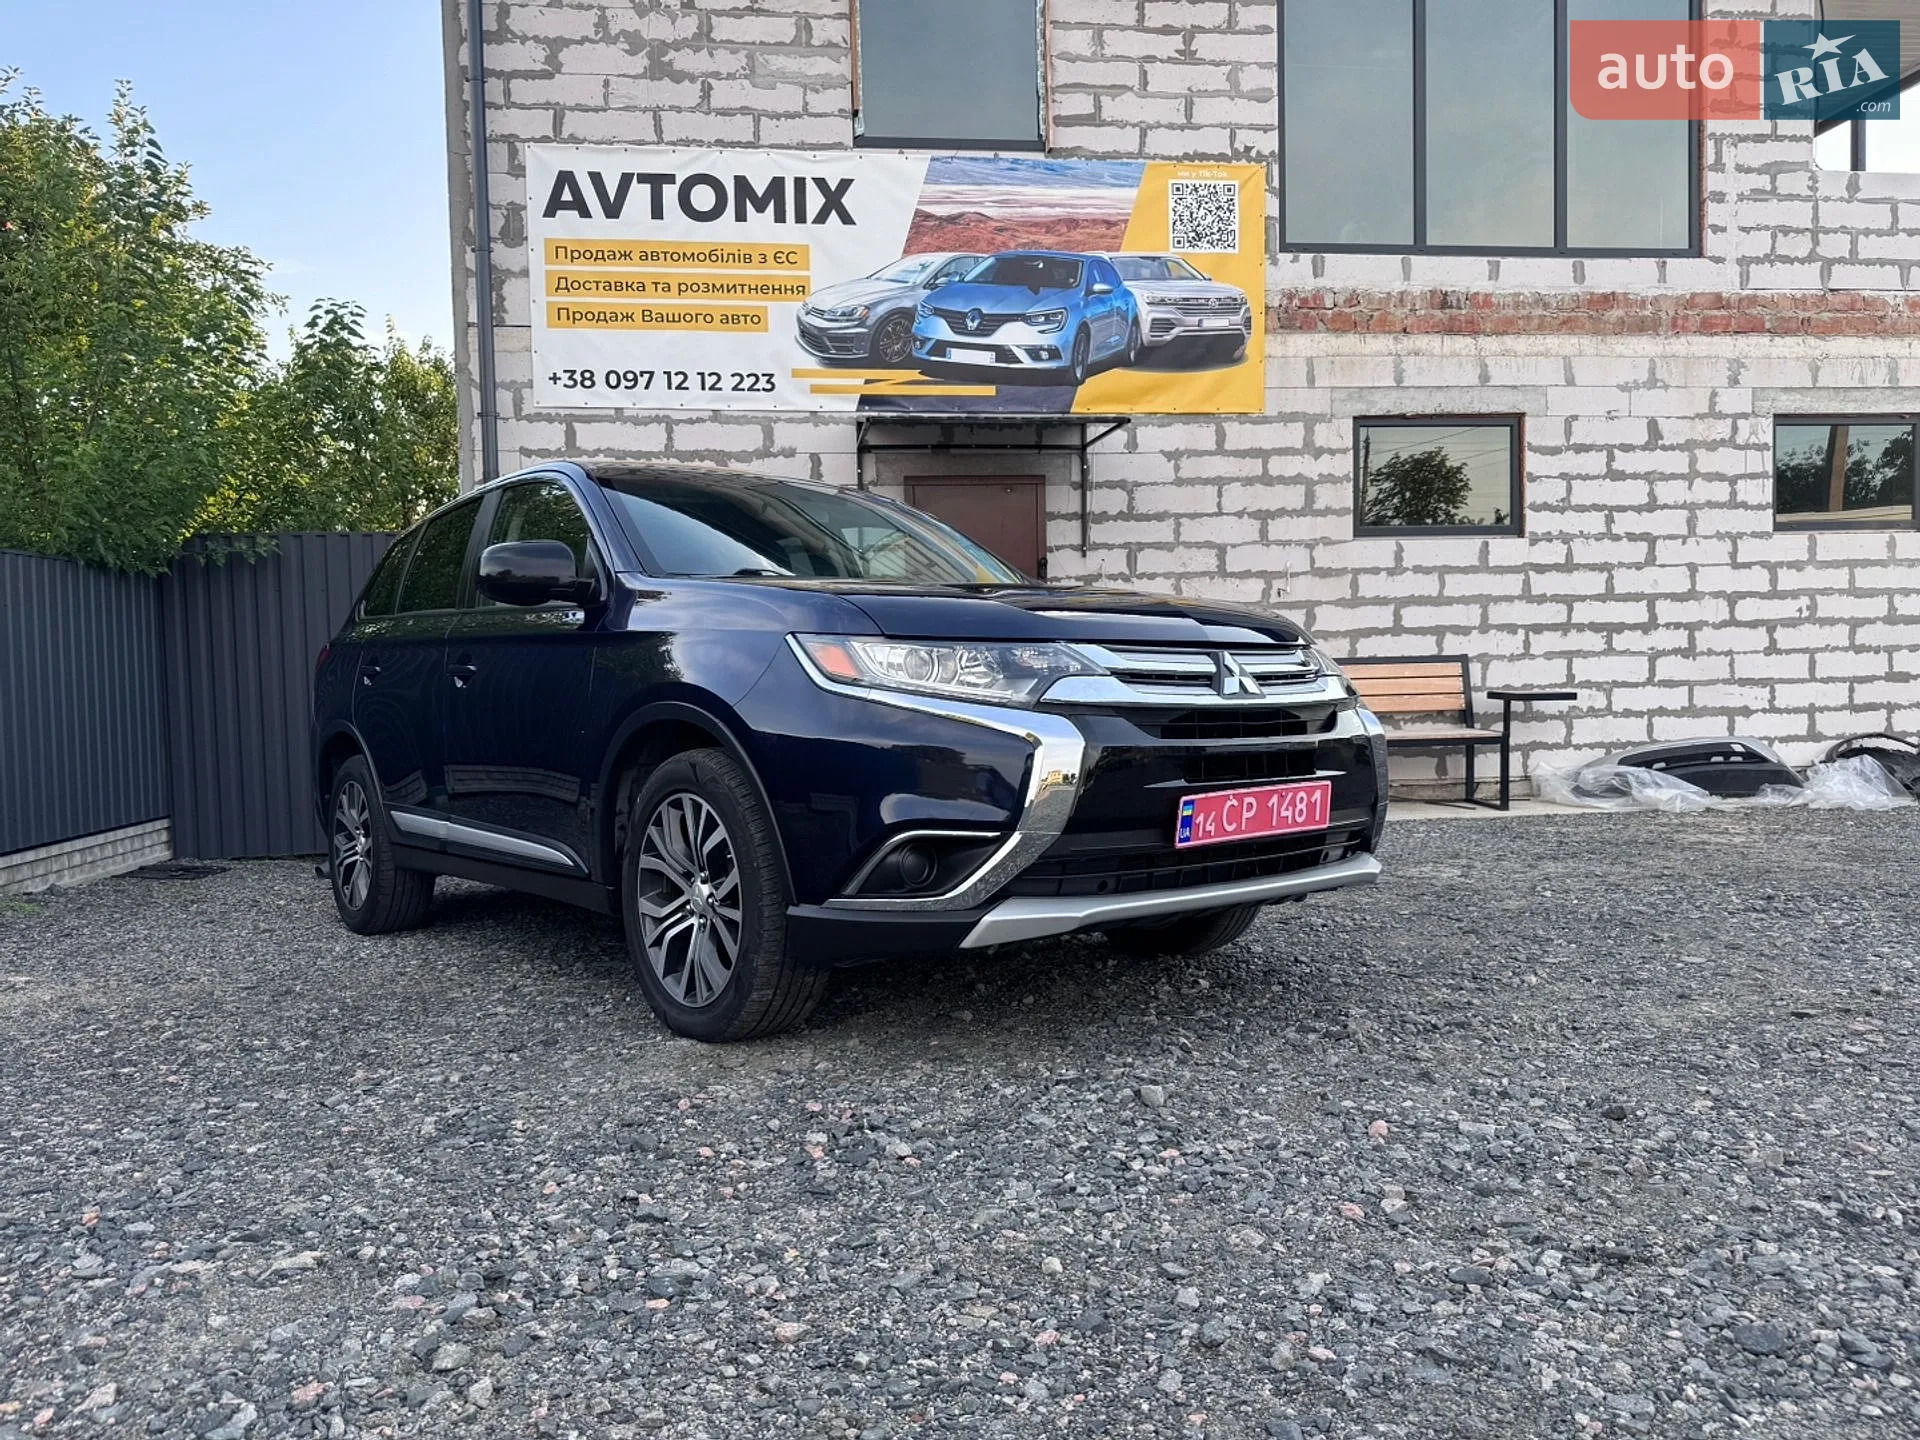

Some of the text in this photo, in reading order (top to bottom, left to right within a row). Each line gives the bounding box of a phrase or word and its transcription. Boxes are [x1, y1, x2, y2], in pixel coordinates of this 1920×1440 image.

[542, 169, 857, 226] AVTOMIX
[554, 245, 799, 265] Продаж автомобілів з ЄС
[555, 276, 806, 298] Доставка та розмитнення
[556, 307, 762, 327] Продаж Вашого авто
[548, 369, 777, 393] +38 097 12 12 223
[1195, 811, 1216, 838] 14
[1267, 788, 1322, 827] 1481
